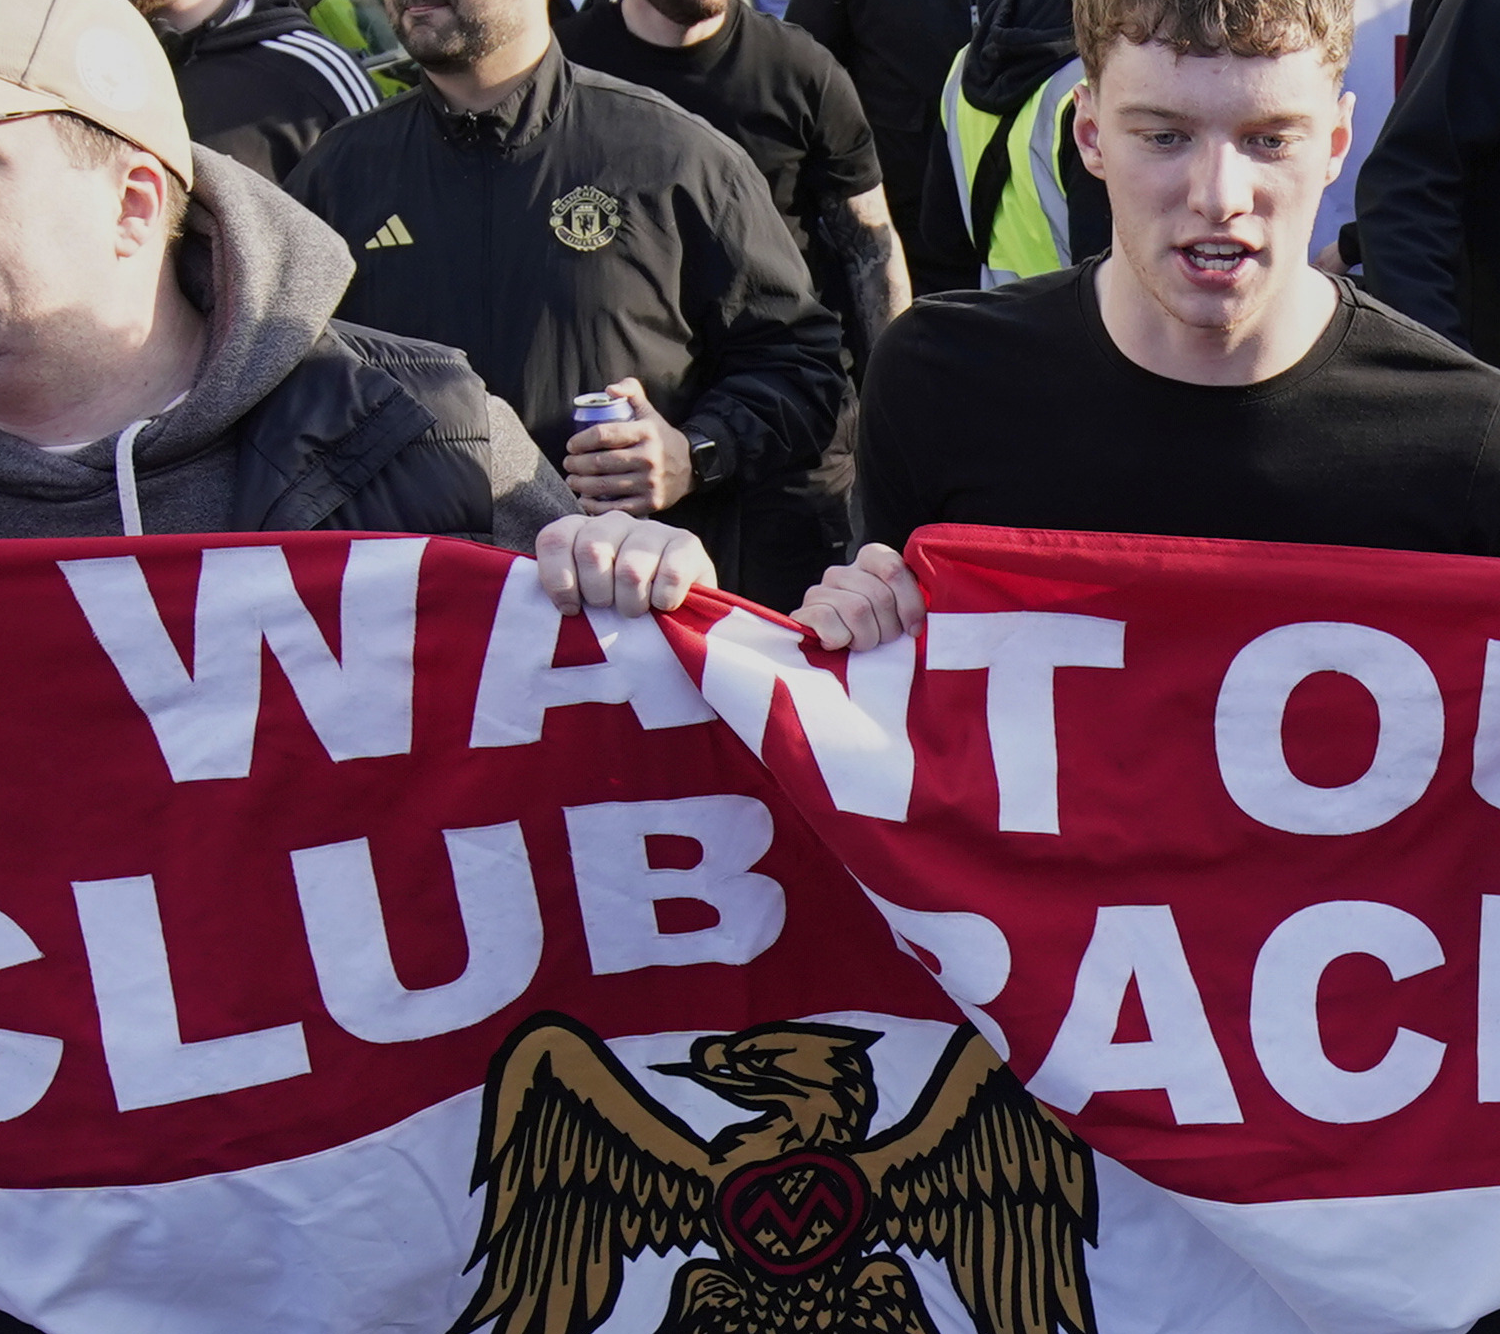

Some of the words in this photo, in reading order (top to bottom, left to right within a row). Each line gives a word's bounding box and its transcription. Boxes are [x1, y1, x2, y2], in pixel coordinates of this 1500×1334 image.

[556, 188, 614, 214] MANCHESTER
[565, 234, 608, 248] UNITED
[56, 536, 1126, 835] WANT
